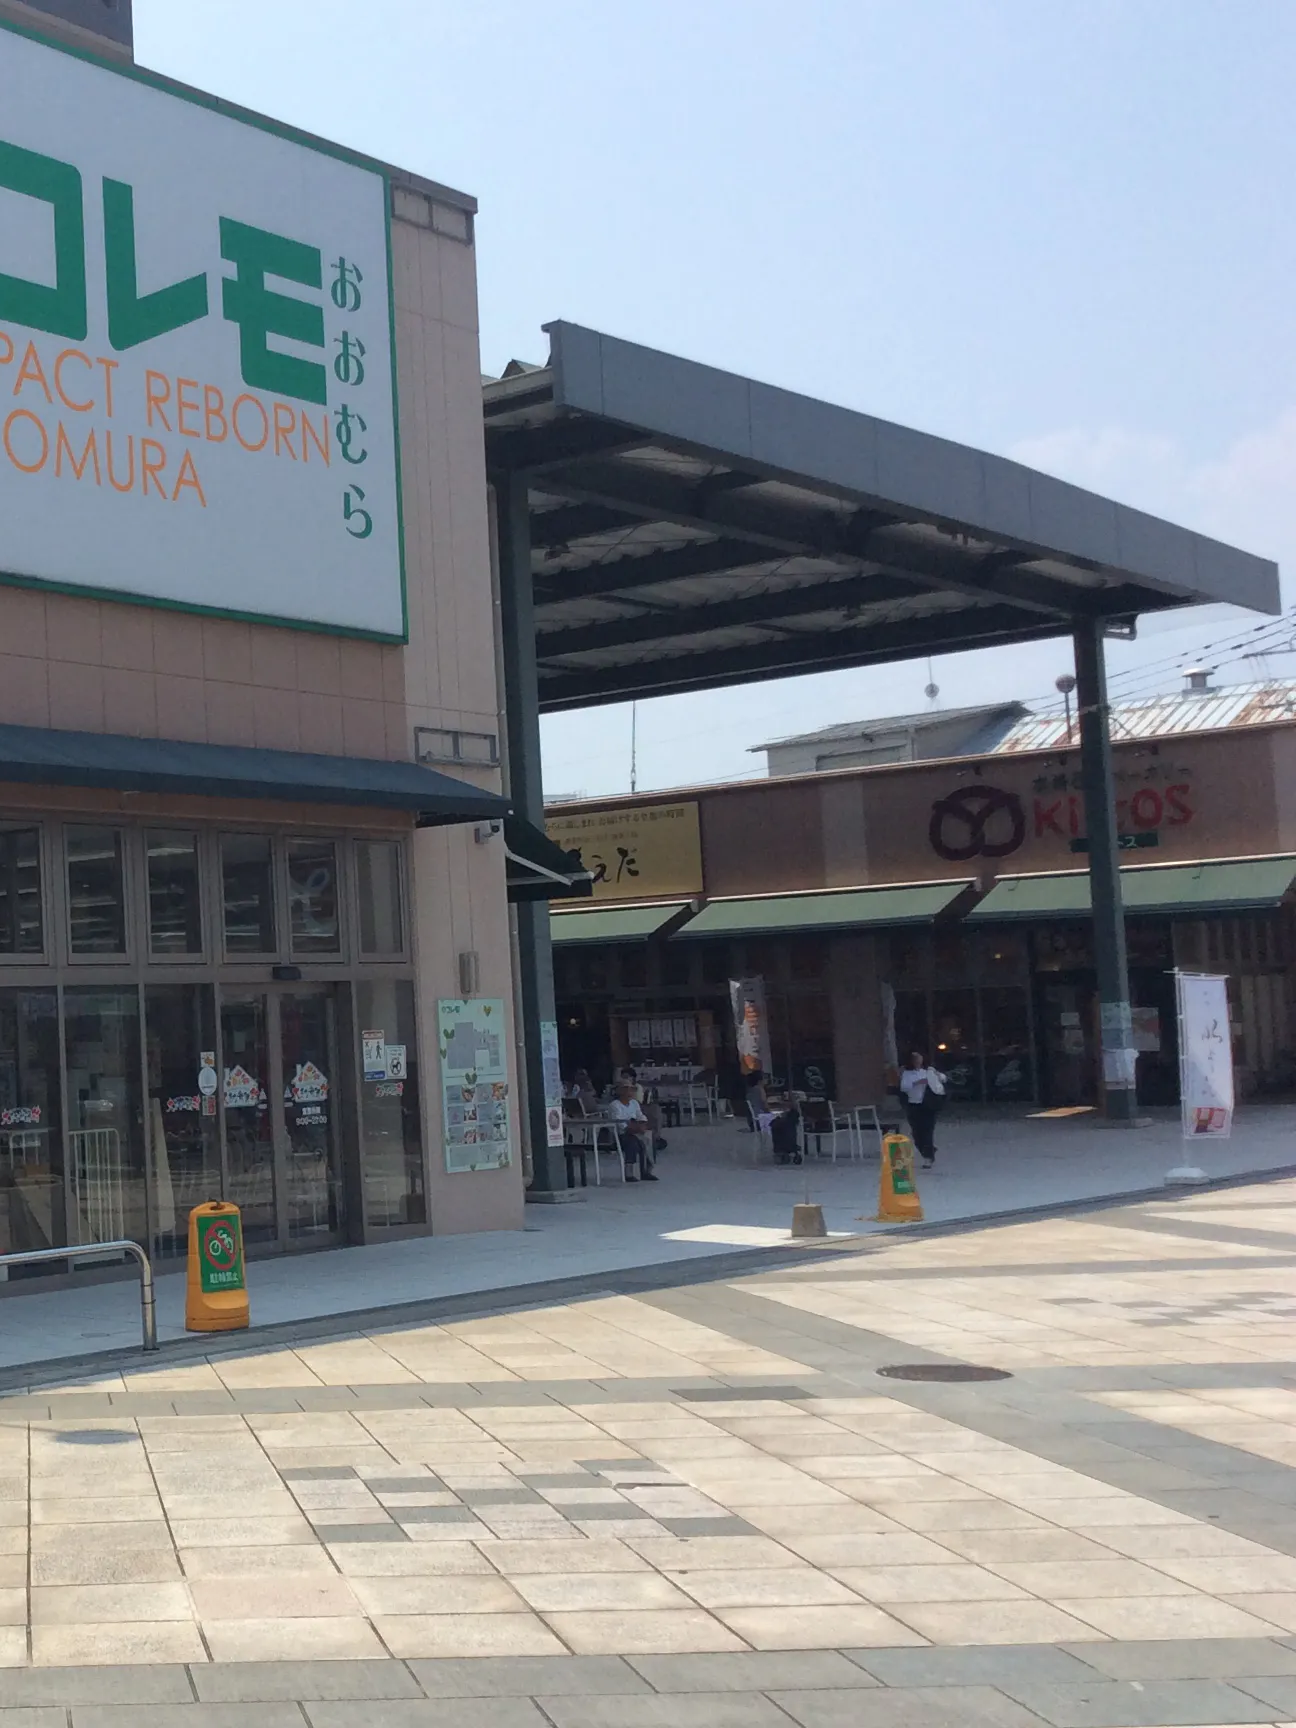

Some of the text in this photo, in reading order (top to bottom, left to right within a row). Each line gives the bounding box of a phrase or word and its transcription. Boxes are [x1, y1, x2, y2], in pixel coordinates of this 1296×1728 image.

[144, 368, 332, 469] REBORN
[330, 255, 373, 540] おおむら
[2, 407, 208, 509] OMURA
